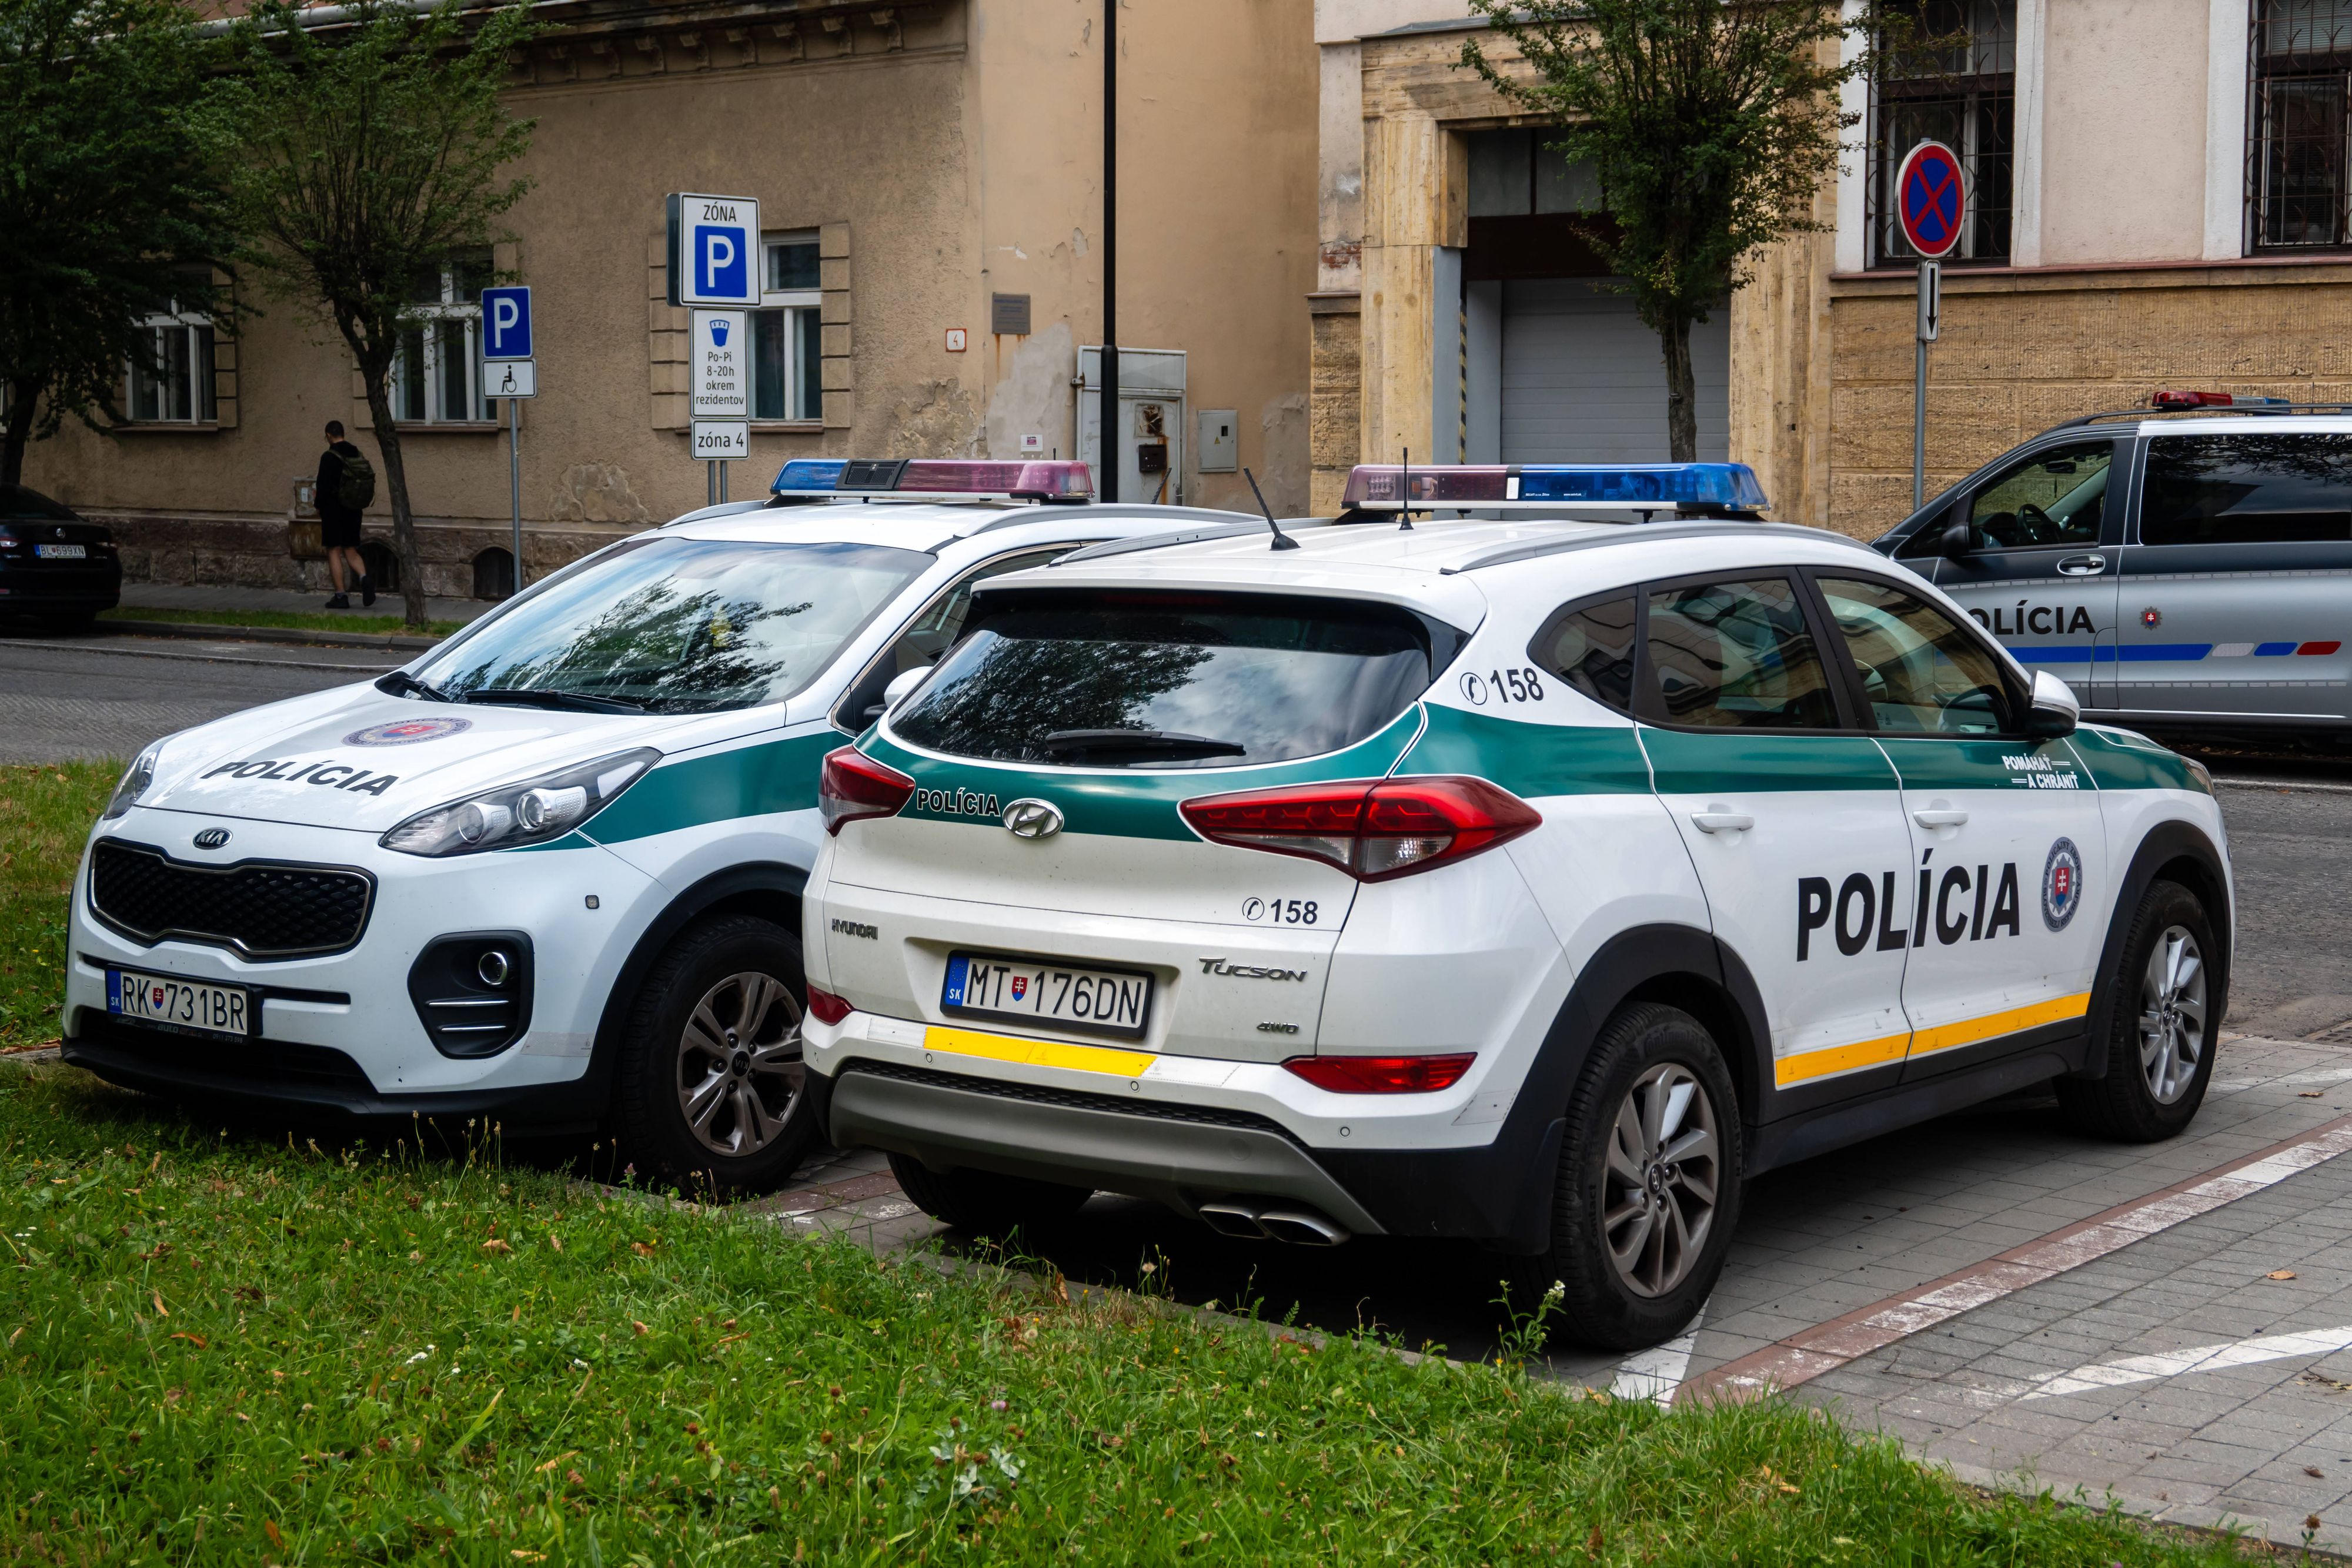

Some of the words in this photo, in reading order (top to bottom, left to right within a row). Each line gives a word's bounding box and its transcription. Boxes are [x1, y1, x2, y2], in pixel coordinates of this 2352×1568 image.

[703, 201, 737, 222] ZÓNA
[707, 235, 734, 287] P
[493, 297, 519, 349] P
[707, 352, 732, 362] Po-Pi
[706, 380, 734, 390] okrem
[696, 394, 744, 405] rezidentov
[698, 432, 730, 449] zóna
[736, 432, 744, 447] 4
[1967, 600, 2096, 635] OLÍCIA
[1489, 667, 1544, 703] 158
[2002, 753, 2052, 771] POMÁHAŤ
[200, 760, 399, 795] POLÍCIA
[2027, 774, 2036, 788] A
[2036, 771, 2079, 789] CHRÁNIŤ
[917, 787, 1001, 817] POLÍCIA
[196, 831, 224, 845] KIA
[1271, 899, 1318, 925] 158
[1796, 848, 2020, 962] POLÍCIA
[832, 918, 878, 940] HYUNDAI
[111, 997, 119, 1007] SK
[123, 975, 151, 1015] RK
[165, 983, 245, 1029] 731BR
[949, 988, 961, 1000] SK
[967, 964, 1010, 1008] MT
[1034, 971, 1142, 1024] 176DN
[1257, 1021, 1299, 1034] 4WD
